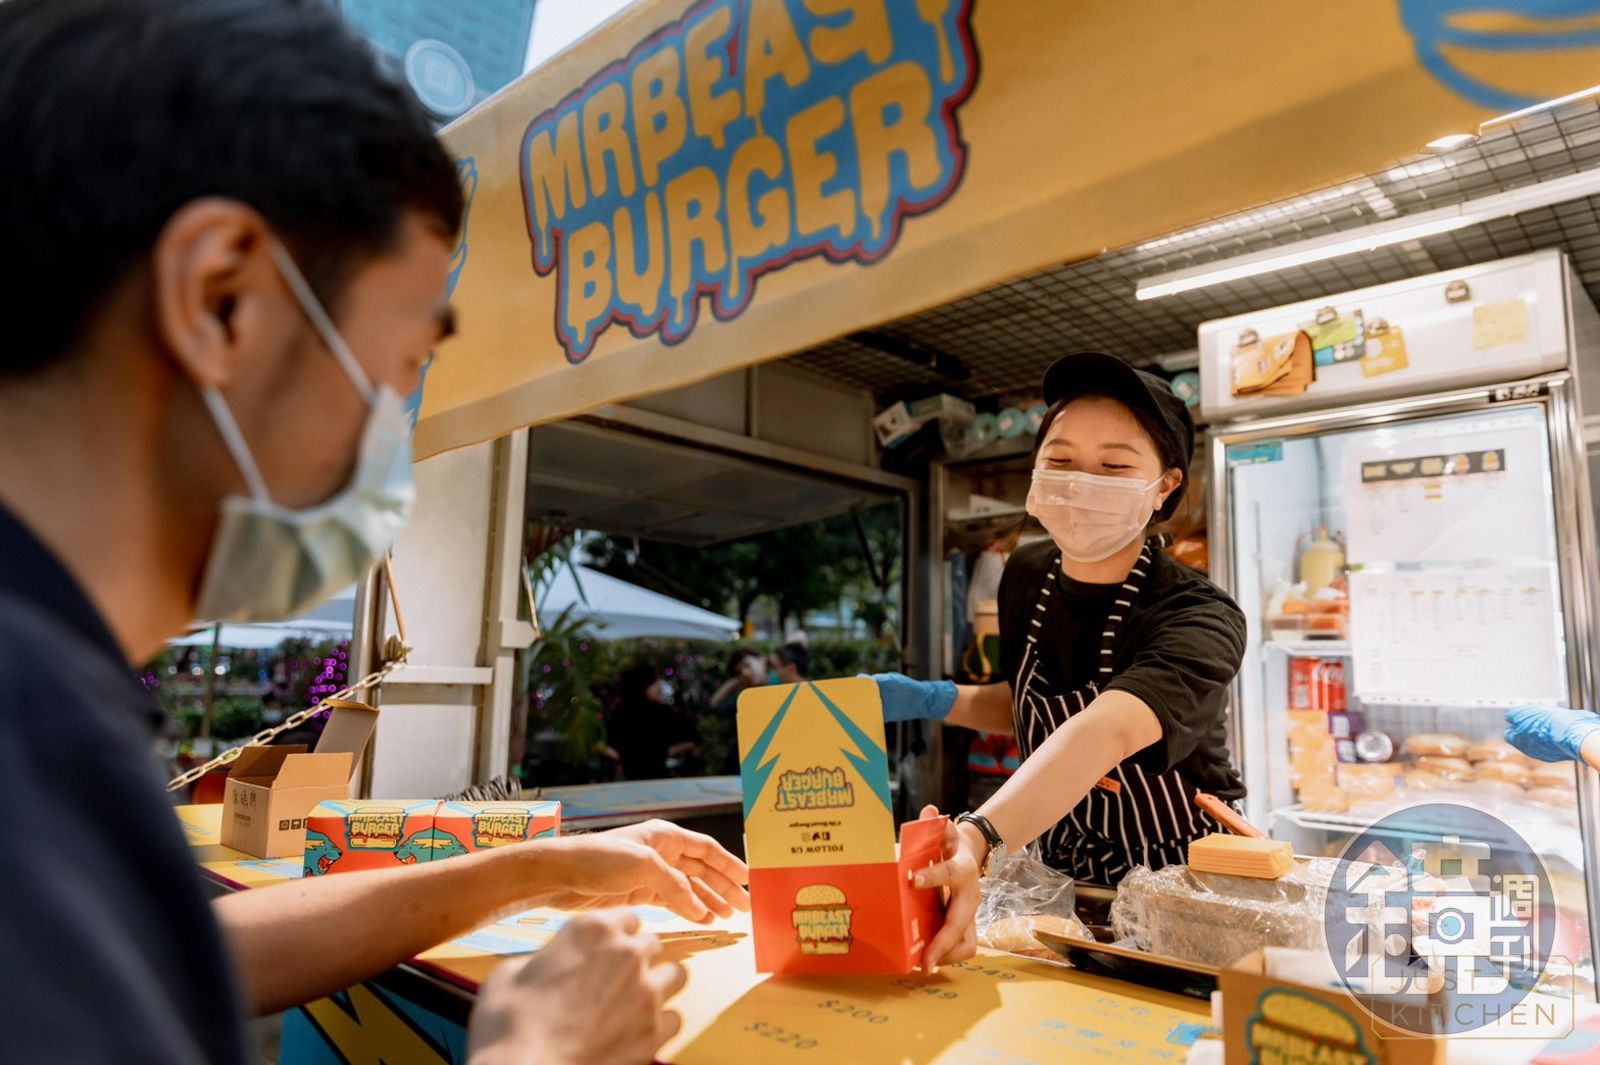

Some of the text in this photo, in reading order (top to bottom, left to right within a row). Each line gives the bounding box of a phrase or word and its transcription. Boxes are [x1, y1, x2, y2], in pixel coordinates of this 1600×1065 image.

[529, 0, 956, 259] MRBEAS
[565, 61, 943, 345] BURGER
[351, 821, 401, 837] BURGER
[477, 820, 525, 837] BURGER
[790, 844, 844, 855] FOLLOW US
[817, 999, 890, 1026] $200
[743, 1021, 819, 1050] $220
